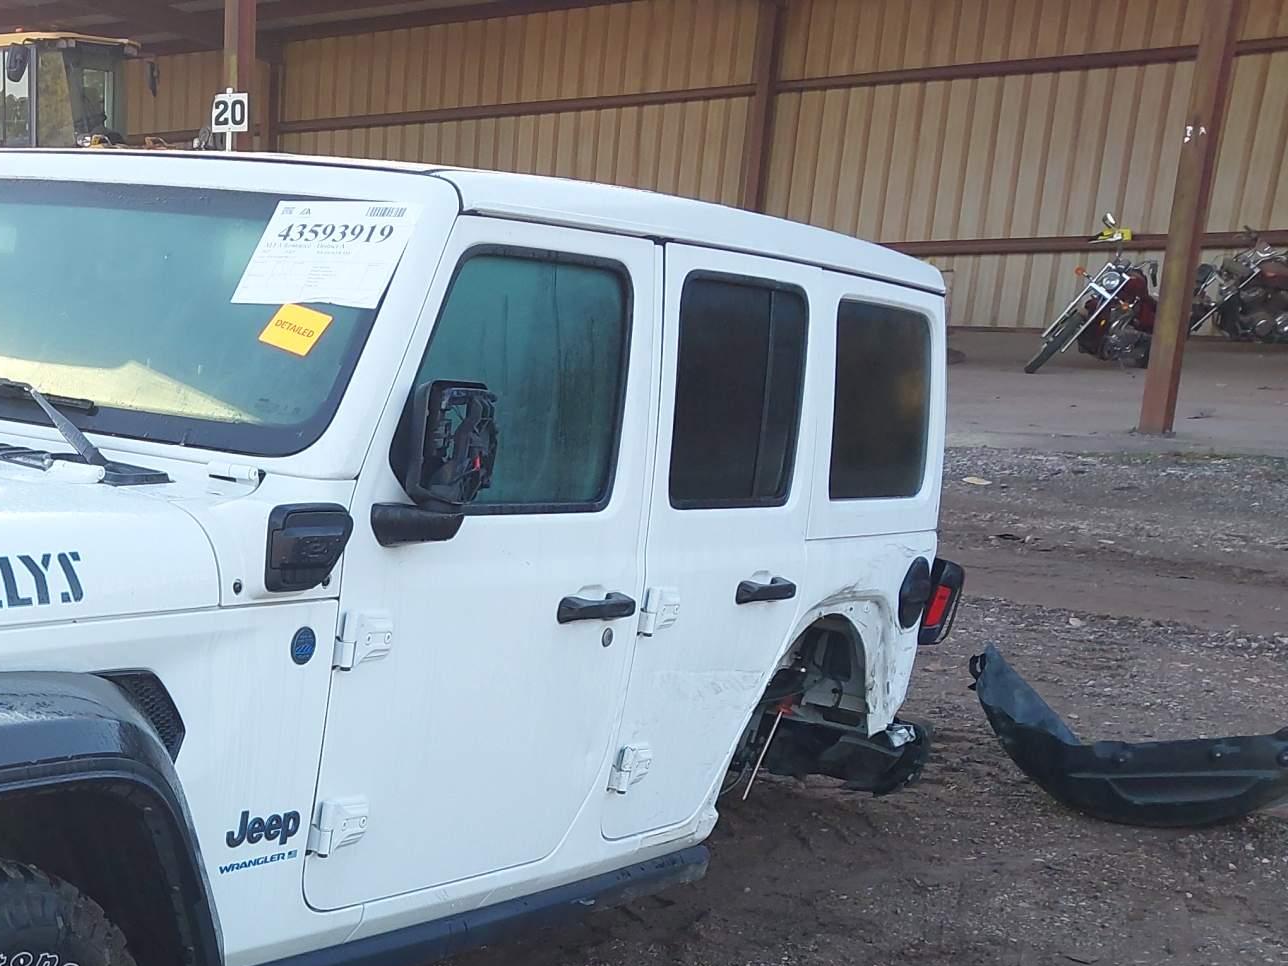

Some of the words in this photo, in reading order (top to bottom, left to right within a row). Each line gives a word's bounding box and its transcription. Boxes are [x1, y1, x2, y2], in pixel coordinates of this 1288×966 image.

[215, 99, 245, 125] 20
[278, 223, 394, 243] 43593919
[274, 319, 315, 338] DETAILED
[225, 810, 300, 848] Jeep
[219, 852, 286, 874] WRANGLER
